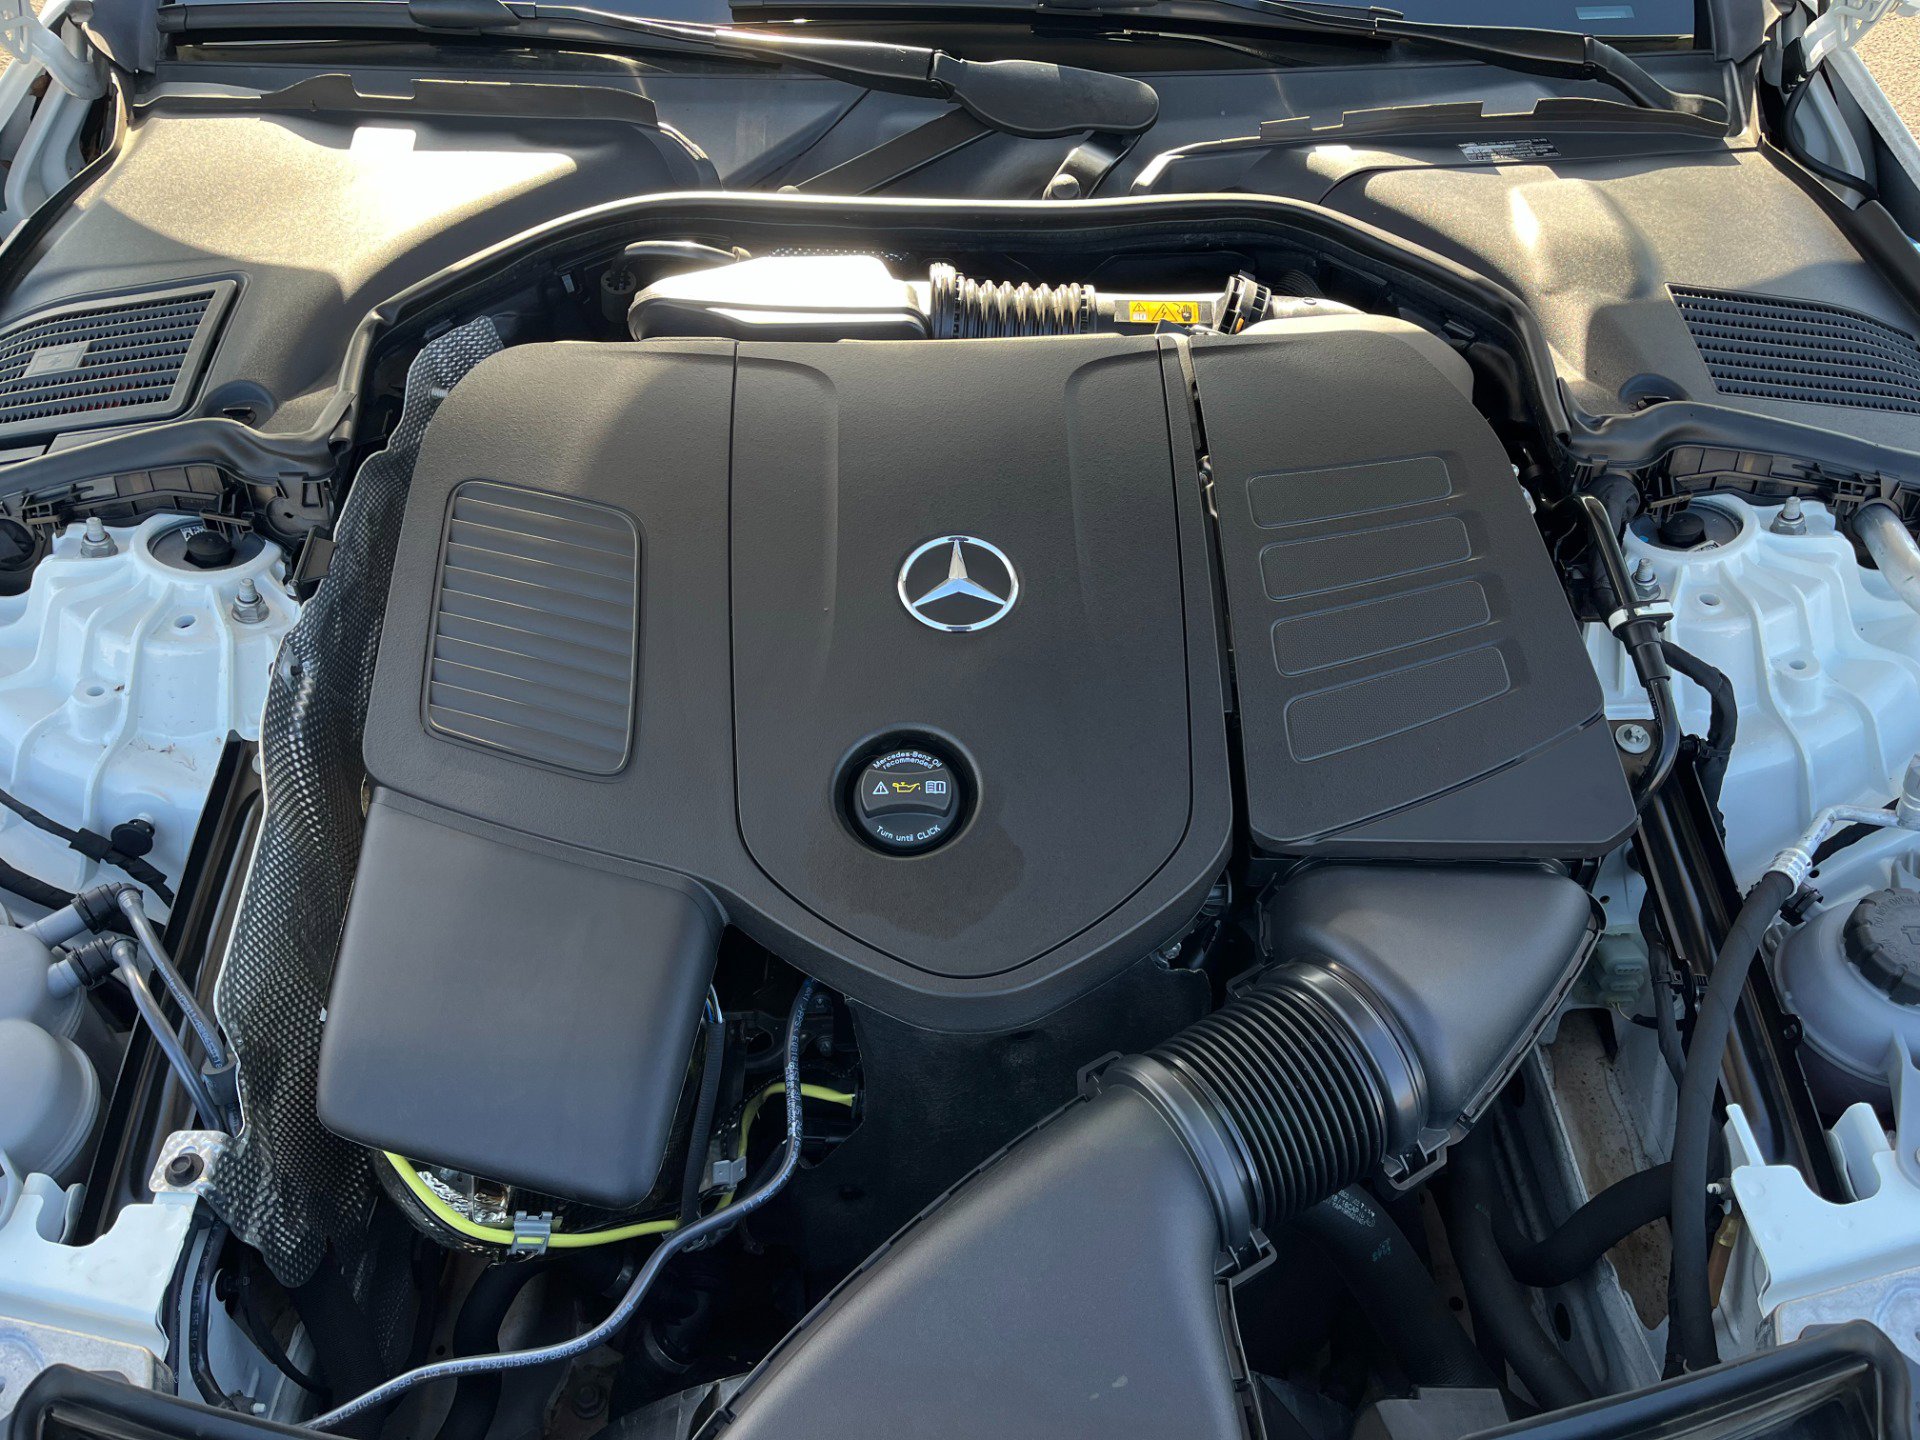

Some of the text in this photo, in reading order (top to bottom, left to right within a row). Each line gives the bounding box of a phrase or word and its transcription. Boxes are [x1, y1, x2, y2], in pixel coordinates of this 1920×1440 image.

[872, 751, 942, 769] Mercedes-Benz Oil
[882, 756, 933, 770] recommended
[876, 825, 893, 839] Turn
[916, 824, 941, 840] CLICK
